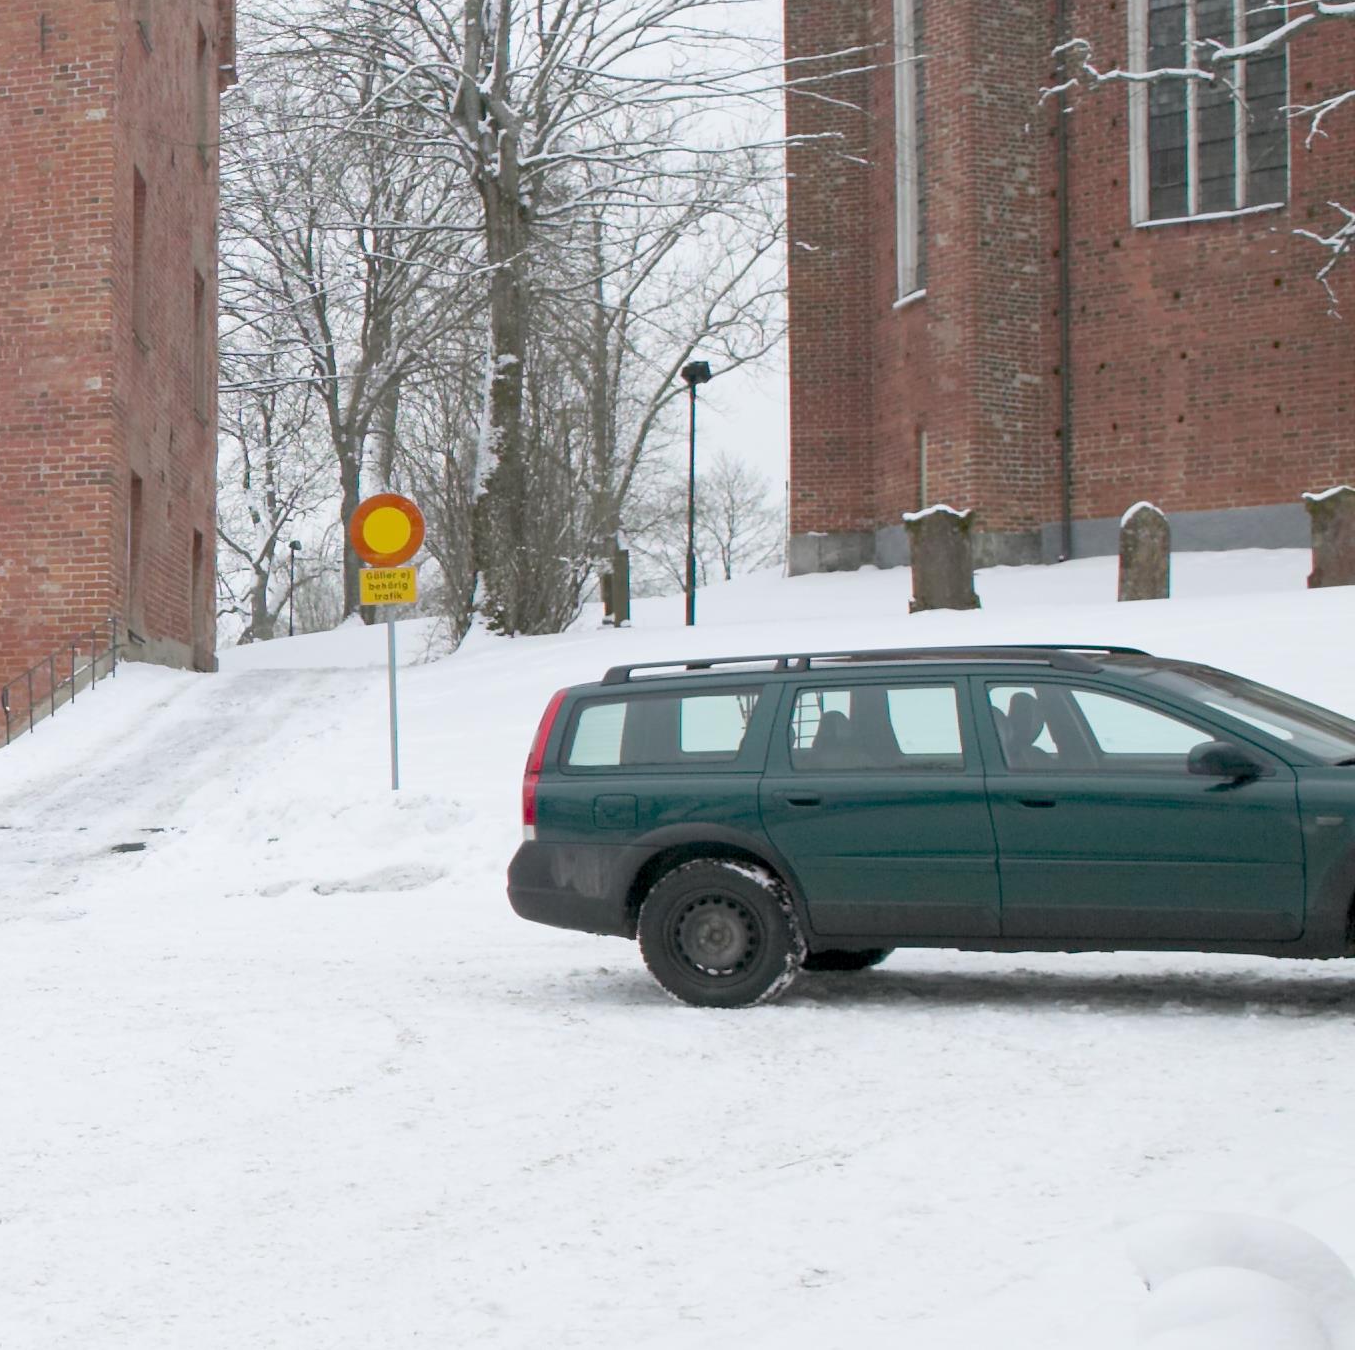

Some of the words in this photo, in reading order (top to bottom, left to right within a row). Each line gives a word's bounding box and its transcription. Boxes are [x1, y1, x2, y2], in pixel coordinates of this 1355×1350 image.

[366, 570, 397, 580] Gäller
[401, 570, 411, 580] ej
[368, 581, 408, 591] behörig
[374, 591, 403, 601] trafik
